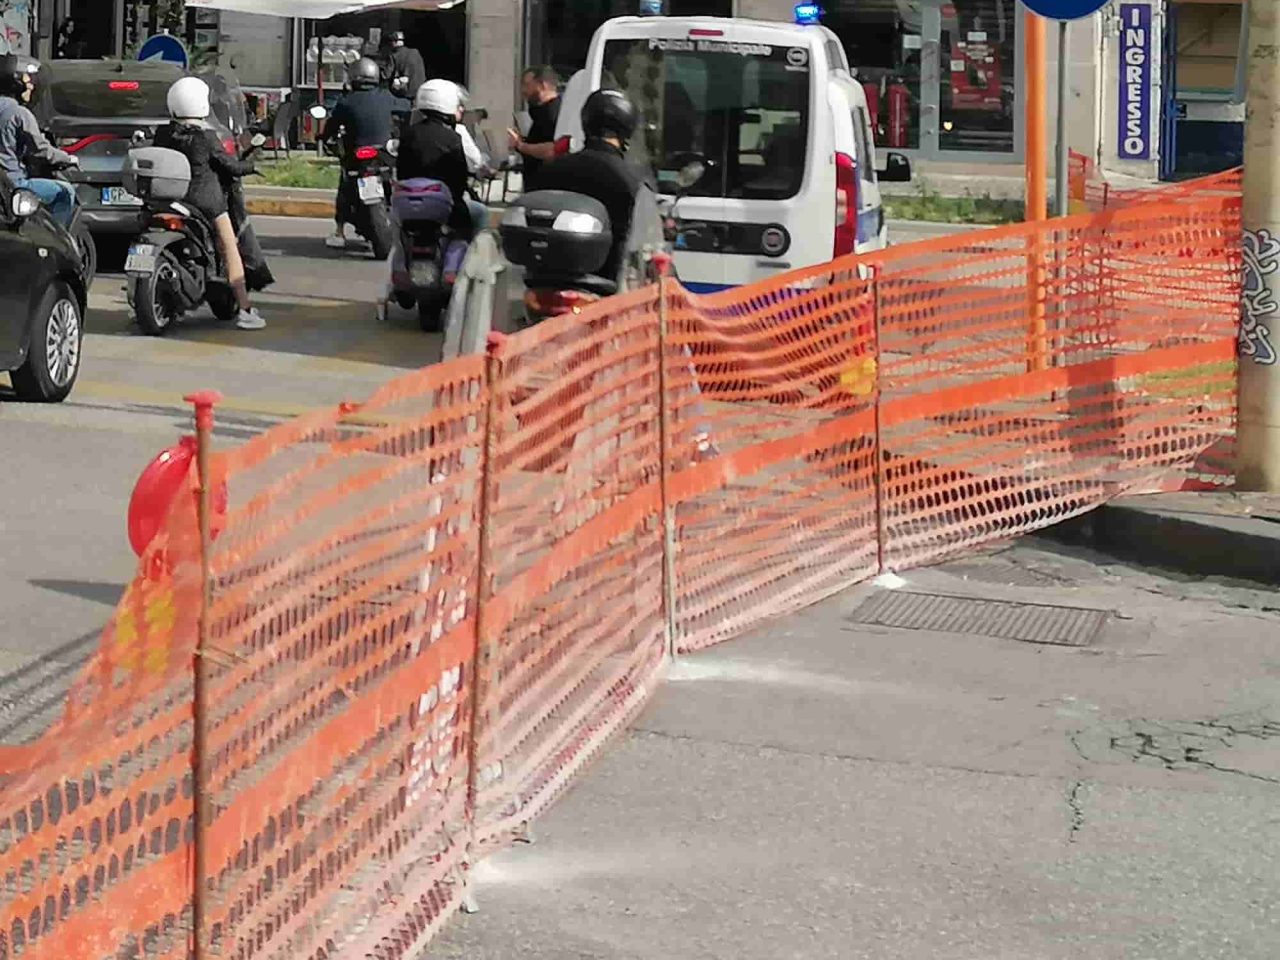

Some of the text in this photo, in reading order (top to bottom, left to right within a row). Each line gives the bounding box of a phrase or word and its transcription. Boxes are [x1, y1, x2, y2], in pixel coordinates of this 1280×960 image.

[648, 38, 773, 57] Polizia Municipale
[1124, 8, 1145, 155] INGRESSO
